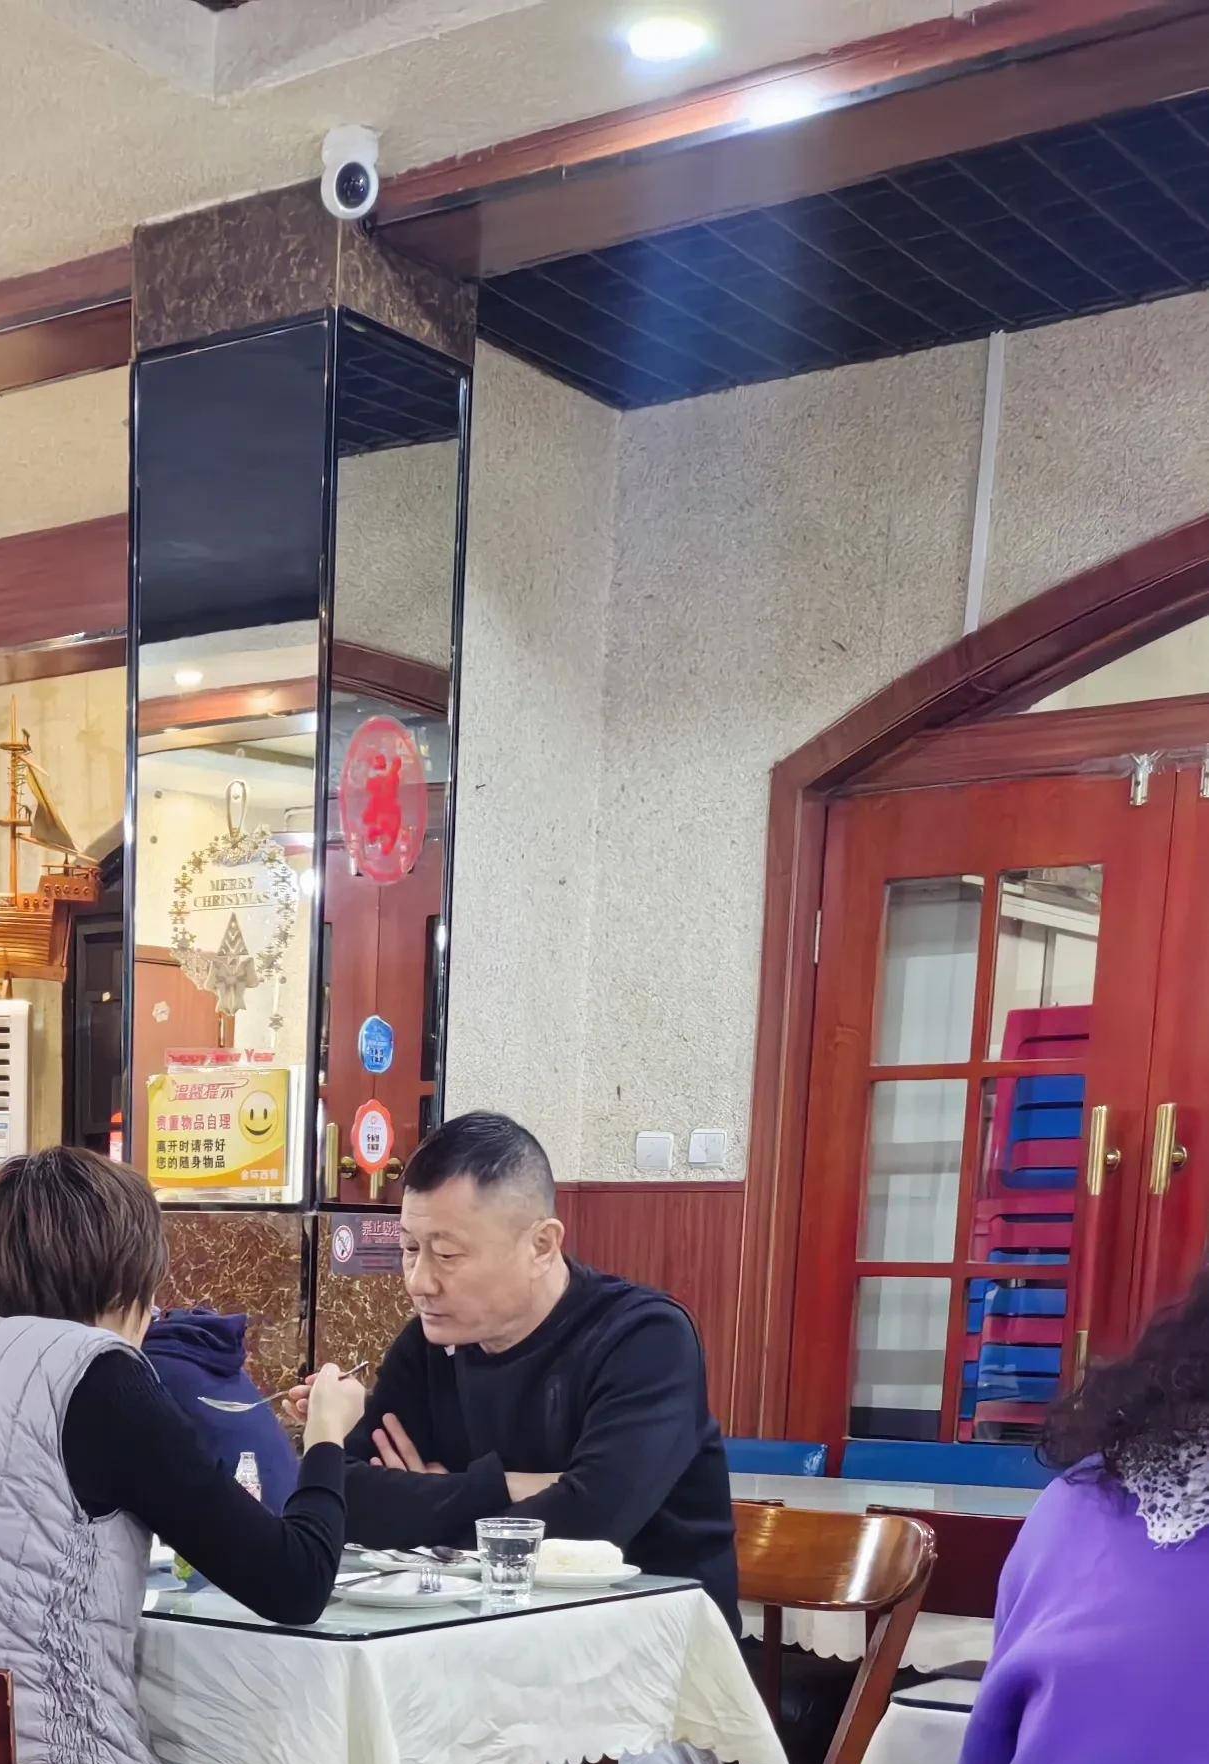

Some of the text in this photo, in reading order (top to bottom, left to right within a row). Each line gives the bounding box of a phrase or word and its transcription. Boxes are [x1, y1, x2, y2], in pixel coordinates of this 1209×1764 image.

[156, 1114, 231, 1131] 贵重物品自理
[156, 1139, 226, 1153] 离开时请带好
[156, 1155, 226, 1169] 您的随身物品
